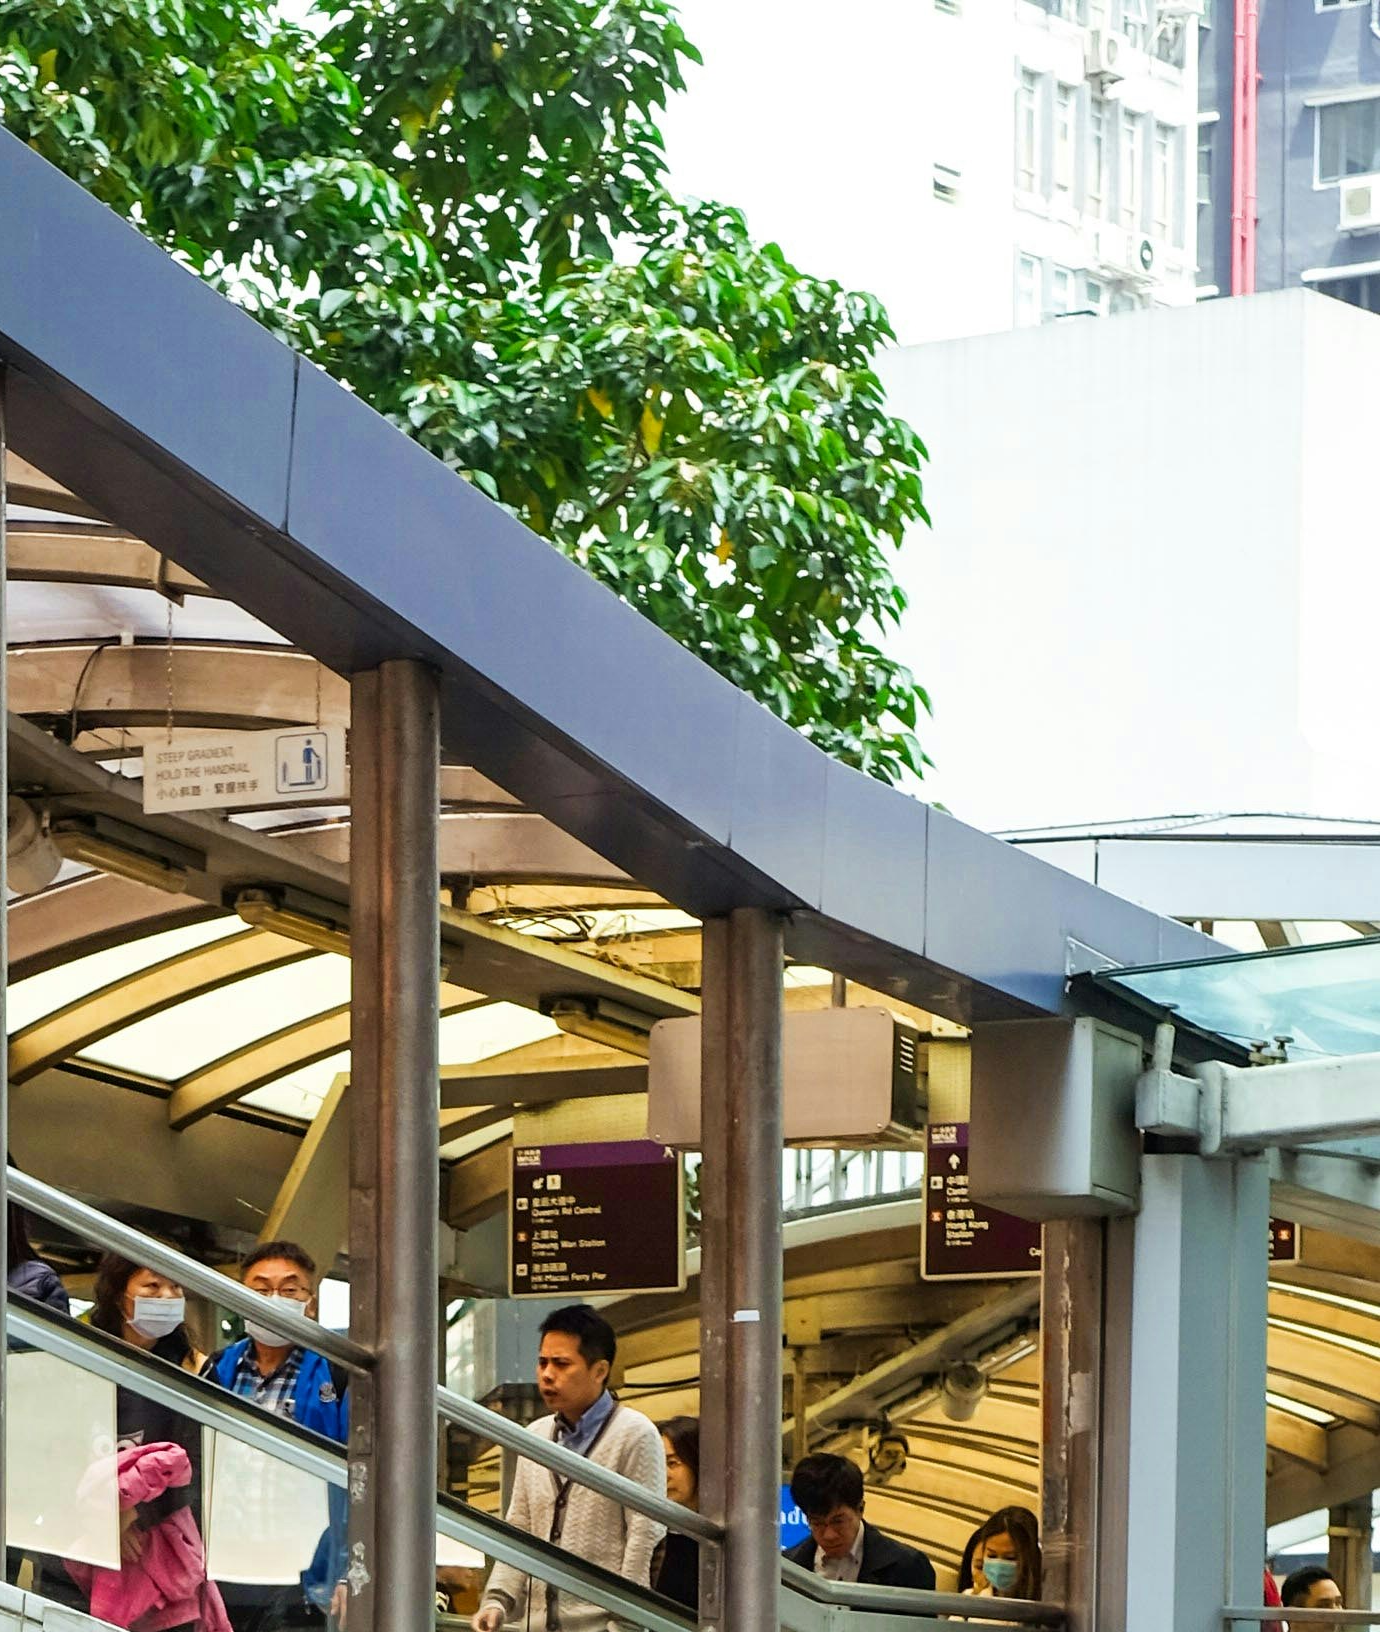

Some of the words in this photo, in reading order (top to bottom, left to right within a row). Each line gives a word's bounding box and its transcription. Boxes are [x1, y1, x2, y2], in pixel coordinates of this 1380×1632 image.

[156, 749, 185, 763] STEEP
[187, 745, 234, 762] GRADIENT
[156, 767, 181, 781] HOLD
[183, 766, 202, 779] THE
[203, 762, 251, 777] HANDRAIL
[968, 1220, 989, 1230] Kong
